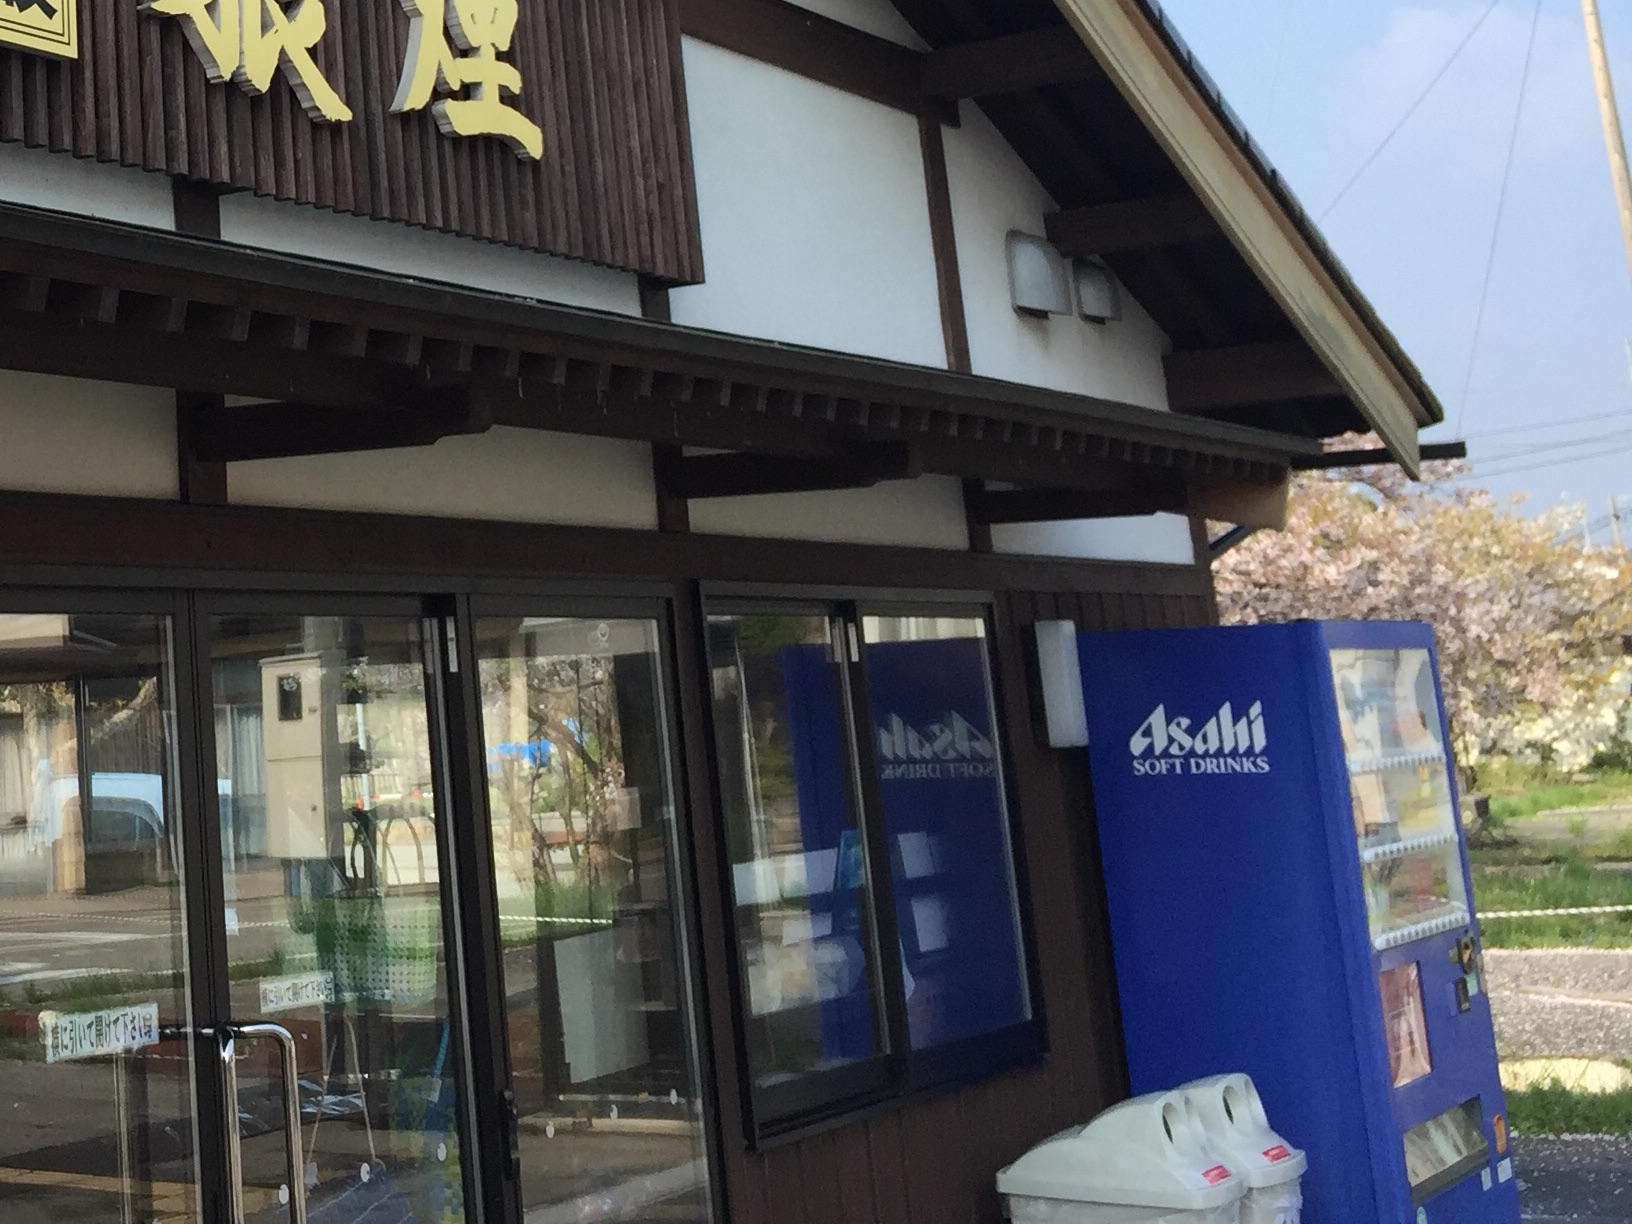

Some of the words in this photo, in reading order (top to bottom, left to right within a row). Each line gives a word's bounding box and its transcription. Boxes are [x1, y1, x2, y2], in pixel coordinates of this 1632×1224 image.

[1129, 700, 1267, 757] Asahi
[1133, 757, 1185, 775] SOFT
[1190, 756, 1270, 774] DRINKS
